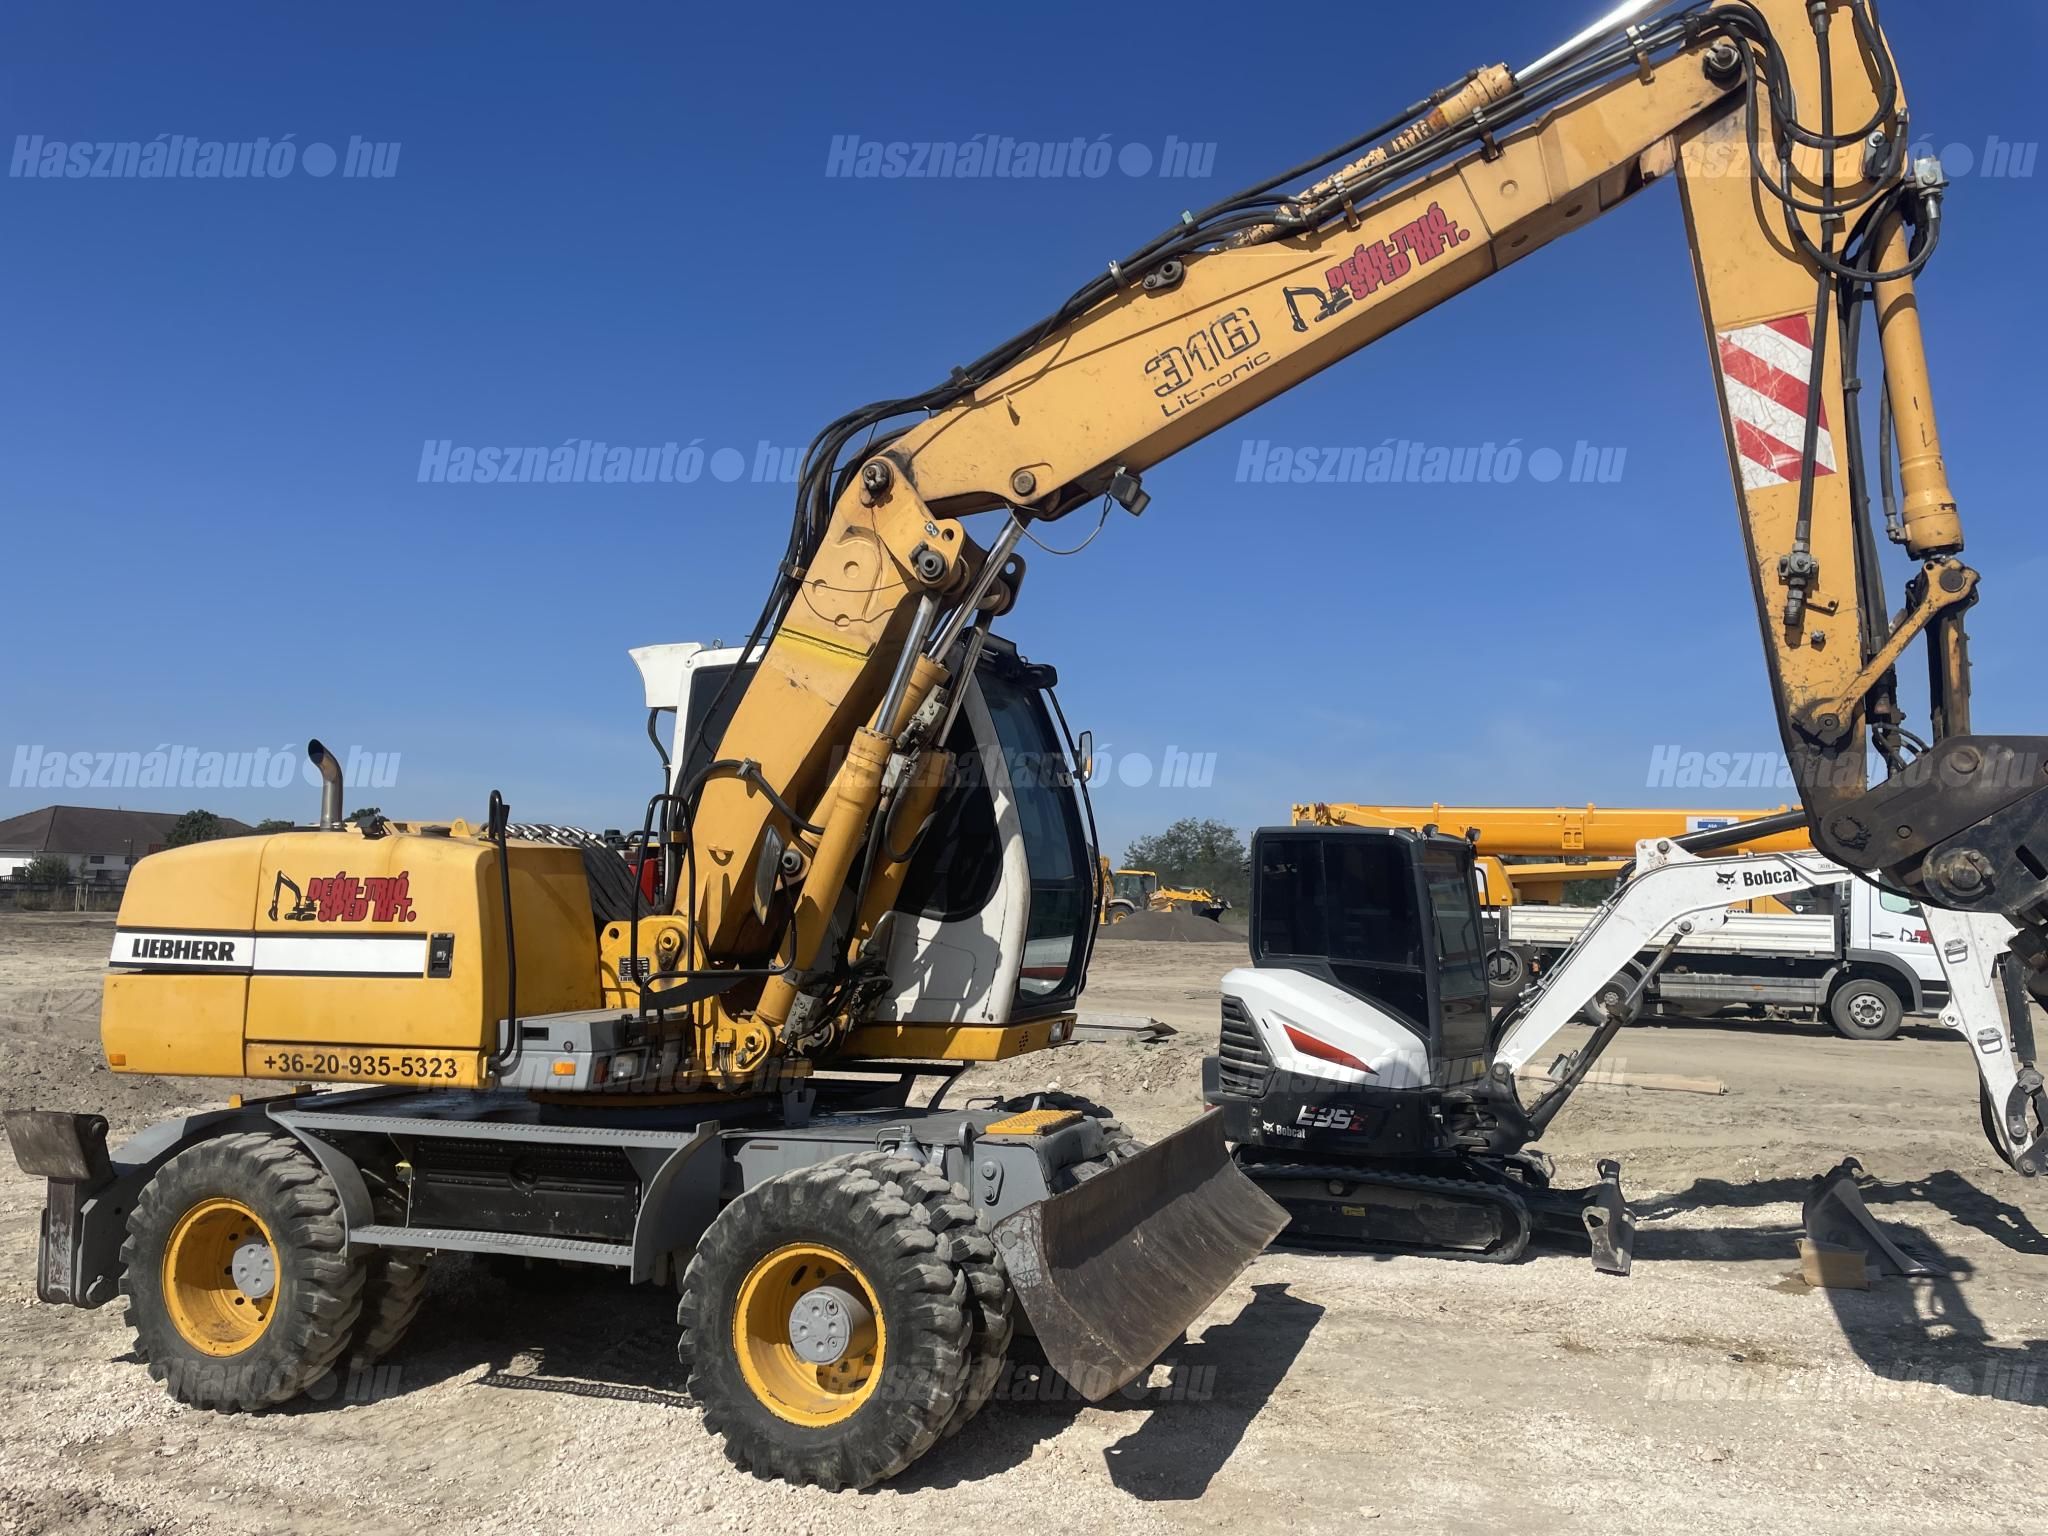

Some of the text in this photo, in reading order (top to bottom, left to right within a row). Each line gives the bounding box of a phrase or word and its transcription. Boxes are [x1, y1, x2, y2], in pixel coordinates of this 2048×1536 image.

[1349, 252, 1411, 300] SPED
[1144, 307, 1261, 398] 316
[1161, 351, 1271, 417] Litronic
[1742, 867, 1799, 888] Bobcat
[318, 898, 368, 922] SPED
[131, 938, 235, 962] LIEBHERR
[264, 1055, 458, 1079] +36-20-935-5323
[1276, 1124, 1306, 1139] Bobcat
